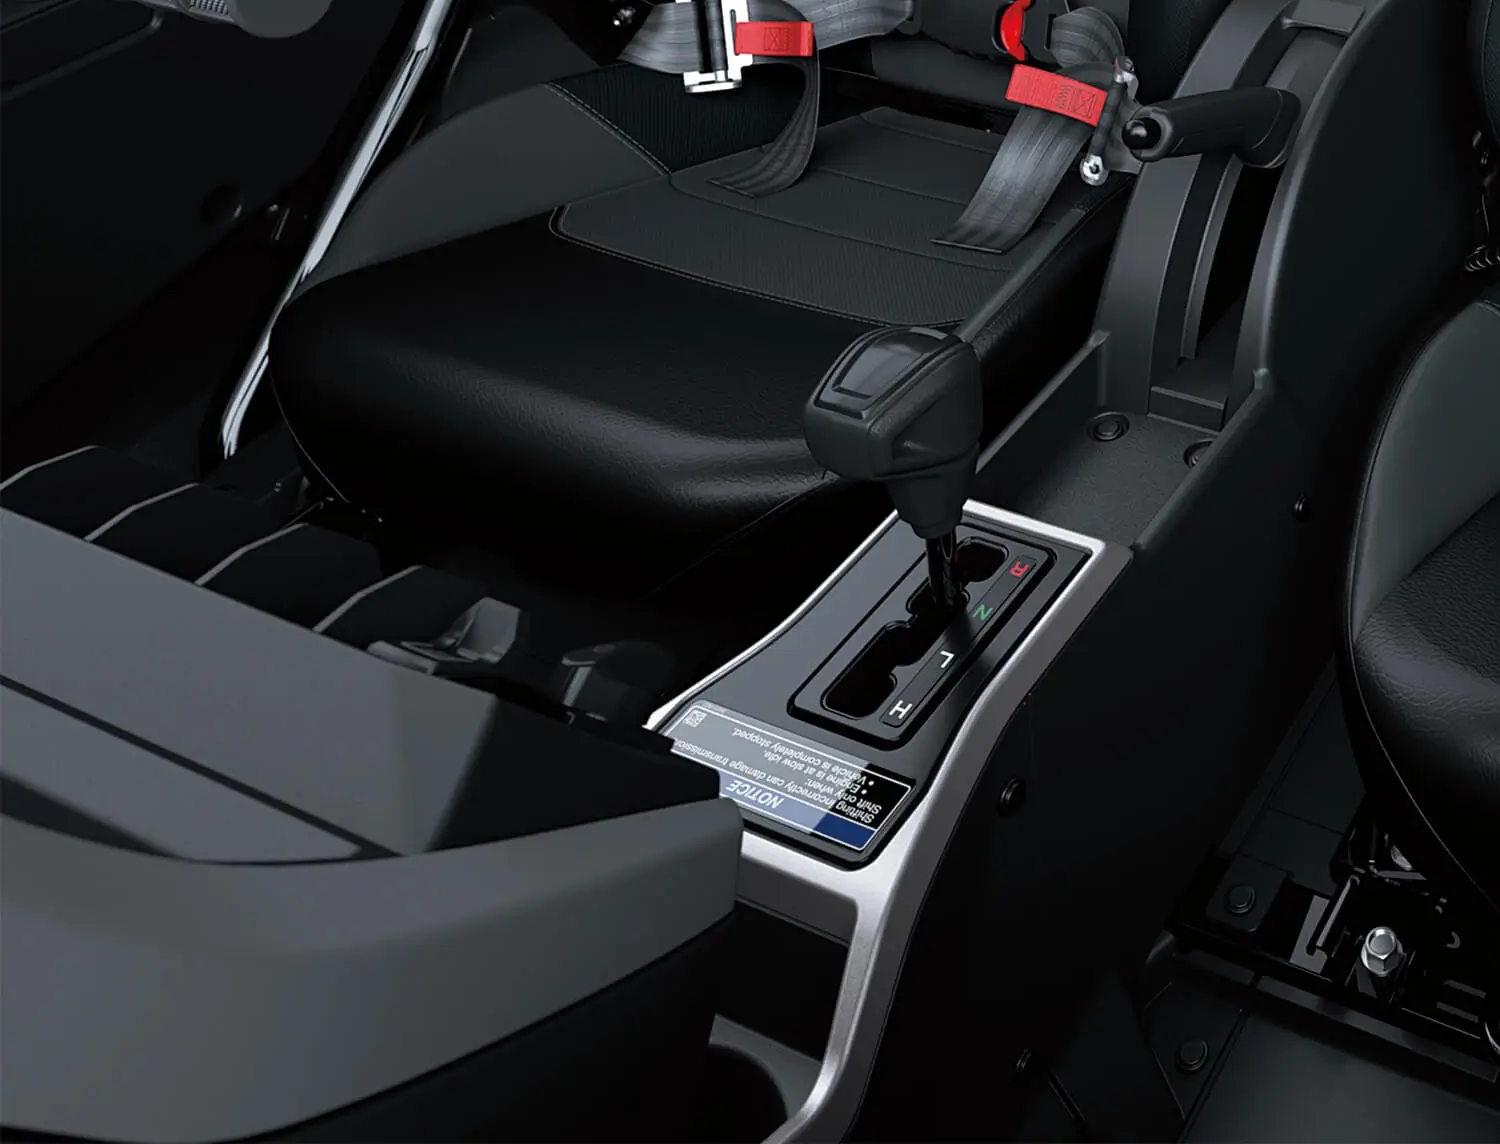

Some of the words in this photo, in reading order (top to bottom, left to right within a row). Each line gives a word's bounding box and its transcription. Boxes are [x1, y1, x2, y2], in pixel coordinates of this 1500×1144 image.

[1009, 560, 1030, 578] R
[972, 603, 994, 622] N
[939, 650, 955, 669] L
[888, 700, 913, 719] H
[732, 727, 771, 747] stopped.
[764, 751, 783, 764] idle.
[771, 742, 821, 766] completely
[729, 760, 767, 780] damage
[782, 758, 805, 772] slow
[803, 766, 817, 776] at
[821, 761, 832, 772] is
[766, 777, 785, 787] can
[815, 770, 826, 780] is
[826, 774, 862, 794] Engine
[830, 766, 867, 786] Vehicle
[726, 780, 785, 809] NOTICE
[784, 781, 836, 809] incorrectly
[804, 778, 834, 795] when:
[834, 788, 857, 803] only
[835, 801, 875, 824] Shifting
[856, 798, 882, 815] Shift
